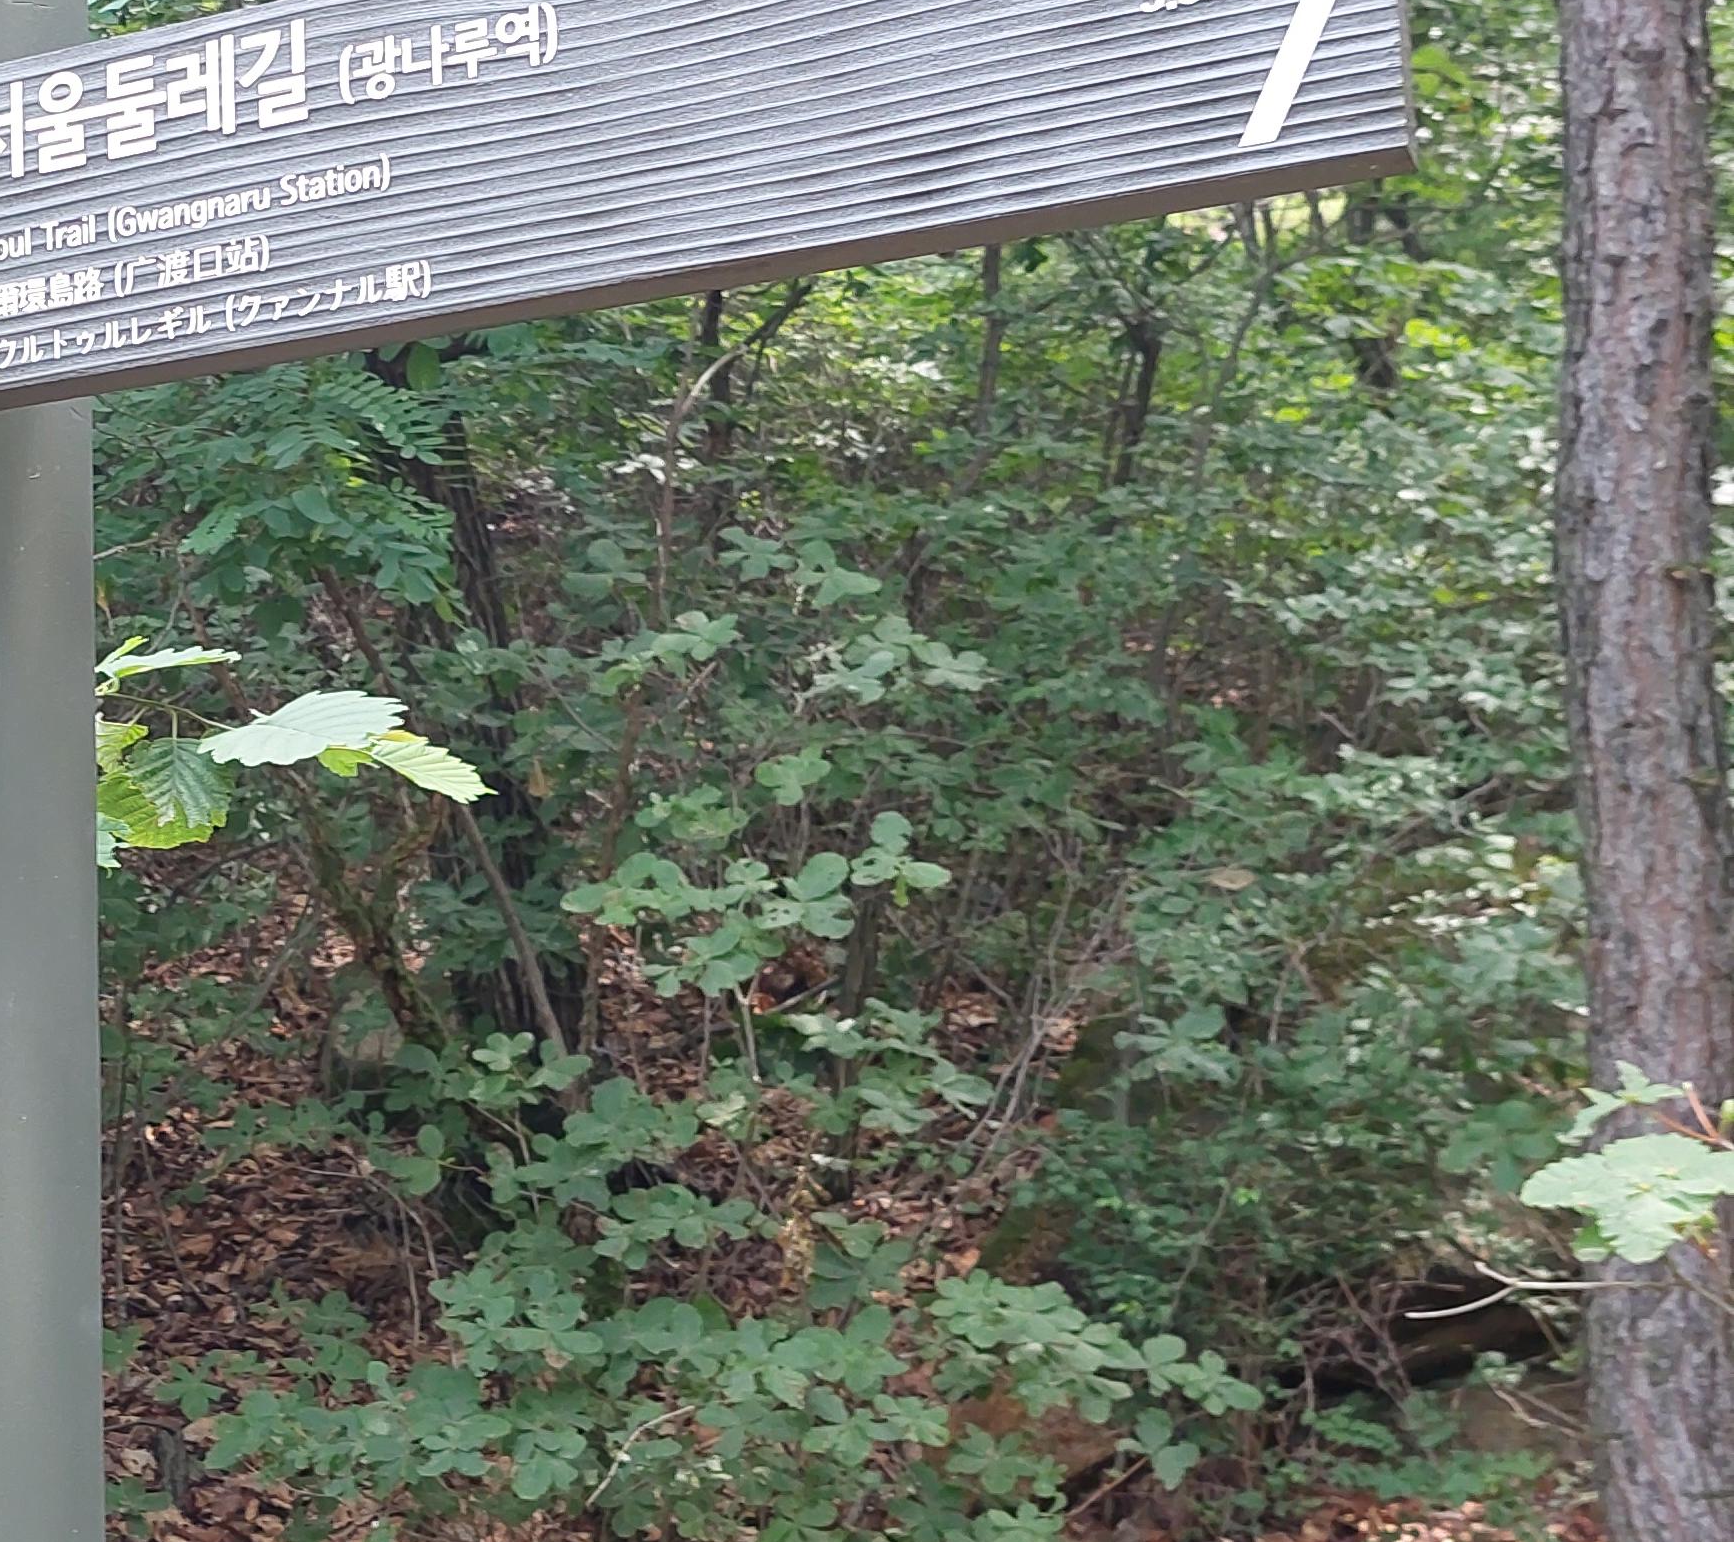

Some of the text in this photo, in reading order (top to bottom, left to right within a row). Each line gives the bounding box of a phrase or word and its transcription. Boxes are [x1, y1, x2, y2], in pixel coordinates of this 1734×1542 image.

[339, 1, 559, 105] (광나루역)
[39, 215, 96, 251] Trail
[107, 185, 272, 244] (Gwangnaru
[280, 153, 391, 207] Station)
[225, 259, 432, 333] (クァンナル駅)
